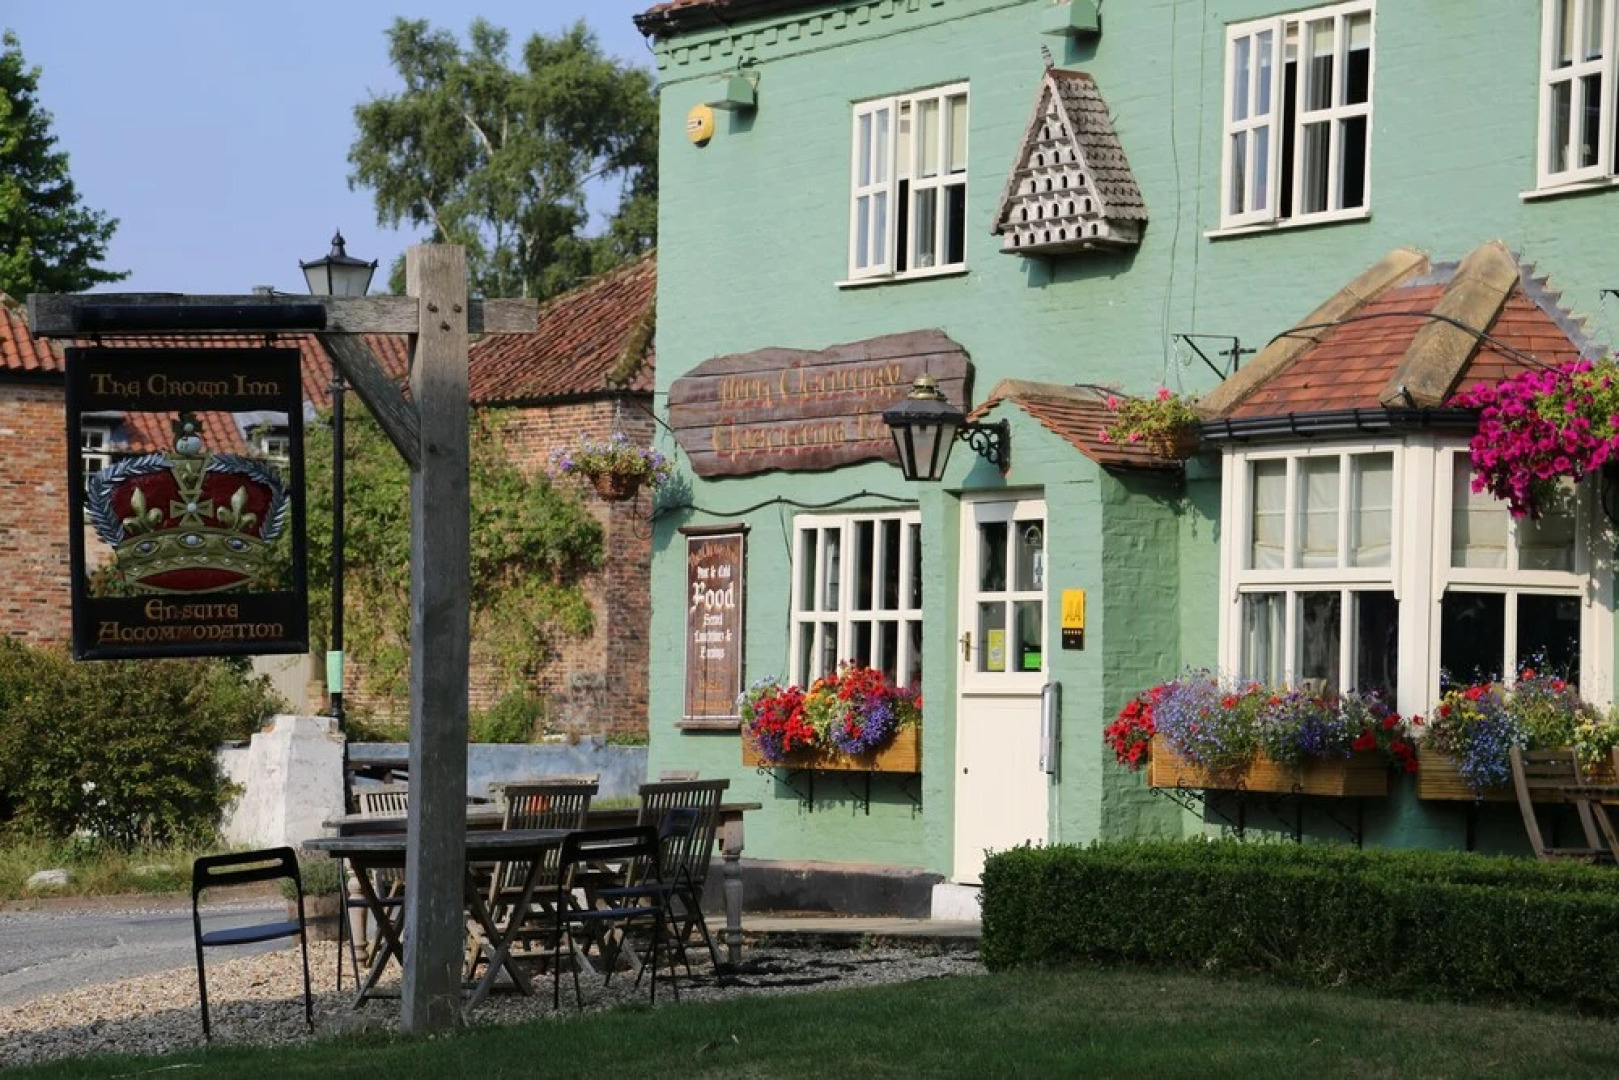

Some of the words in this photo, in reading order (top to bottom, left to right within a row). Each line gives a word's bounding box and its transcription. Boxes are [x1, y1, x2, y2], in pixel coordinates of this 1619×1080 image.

[90, 372, 140, 397] The
[147, 373, 229, 398] Crown
[233, 373, 282, 397] Inn
[690, 580, 736, 614] Food
